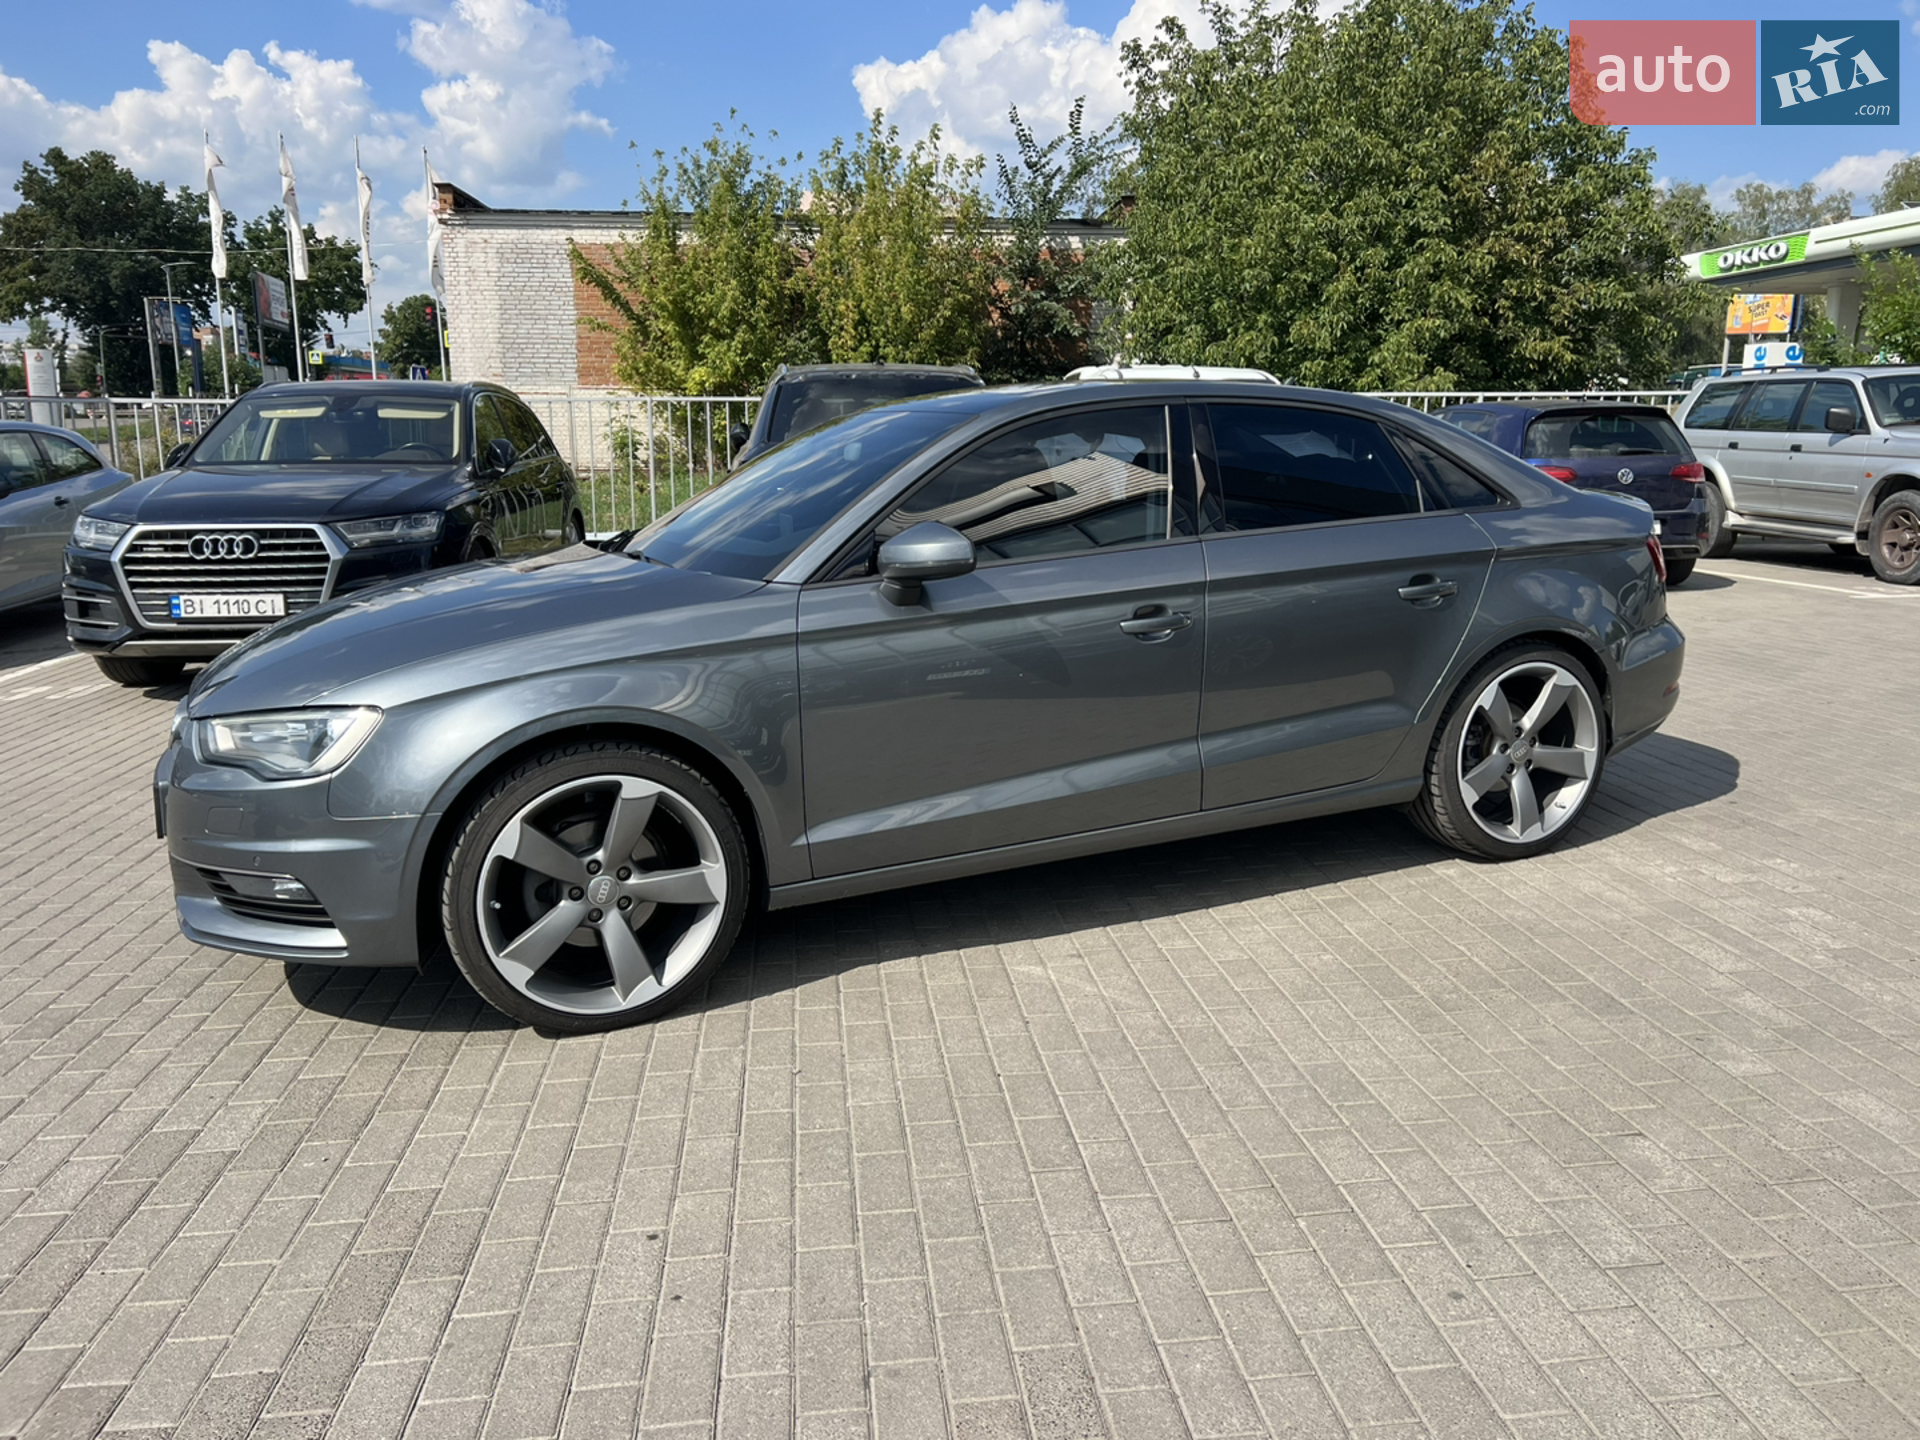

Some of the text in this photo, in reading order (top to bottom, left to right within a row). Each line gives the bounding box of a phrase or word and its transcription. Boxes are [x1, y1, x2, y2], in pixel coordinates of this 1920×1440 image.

[1718, 242, 1788, 270] OKKO
[184, 599, 276, 615] BI 1110 CI
